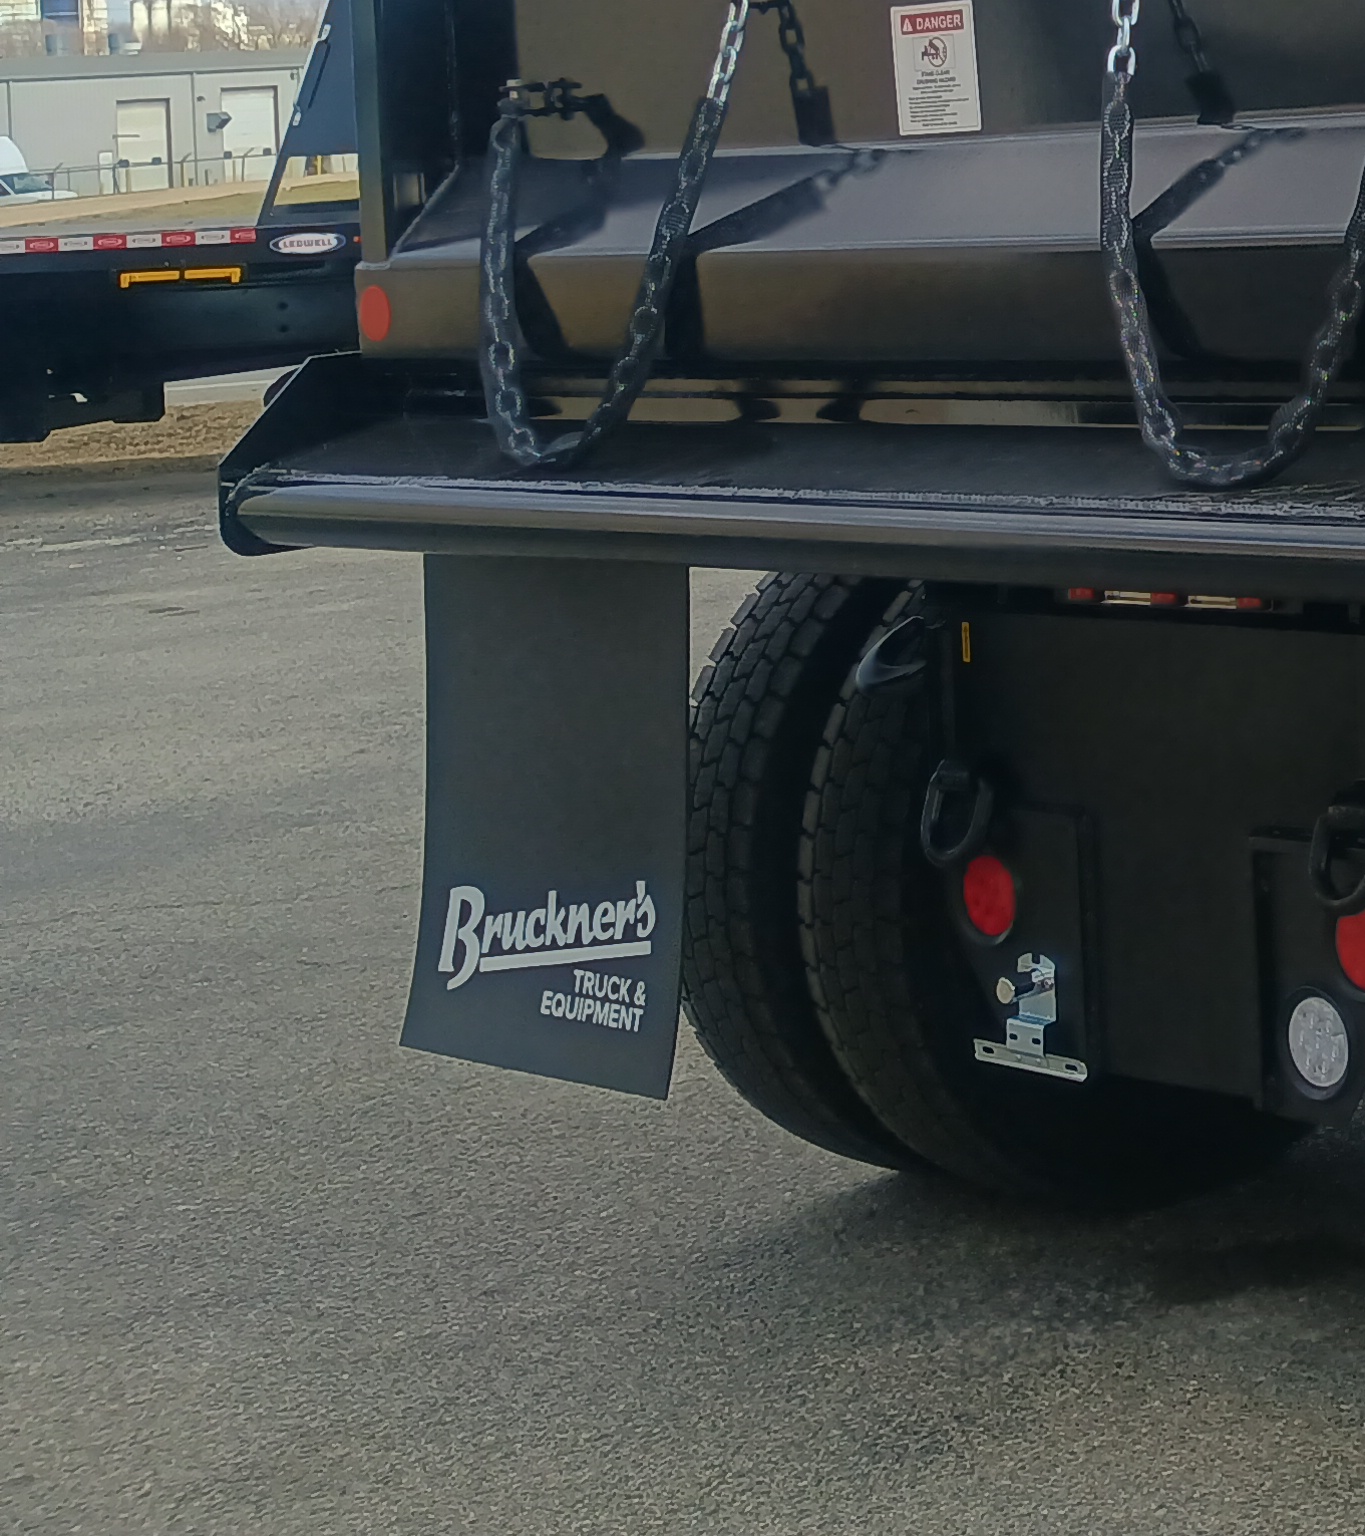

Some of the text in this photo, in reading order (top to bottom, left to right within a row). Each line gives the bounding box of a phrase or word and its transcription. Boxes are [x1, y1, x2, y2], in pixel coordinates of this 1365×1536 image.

[916, 13, 962, 31] DANGER
[437, 880, 656, 991] Bruckner's
[573, 969, 646, 1006] TRUCK &
[540, 990, 644, 1033] EQUIPMENT
